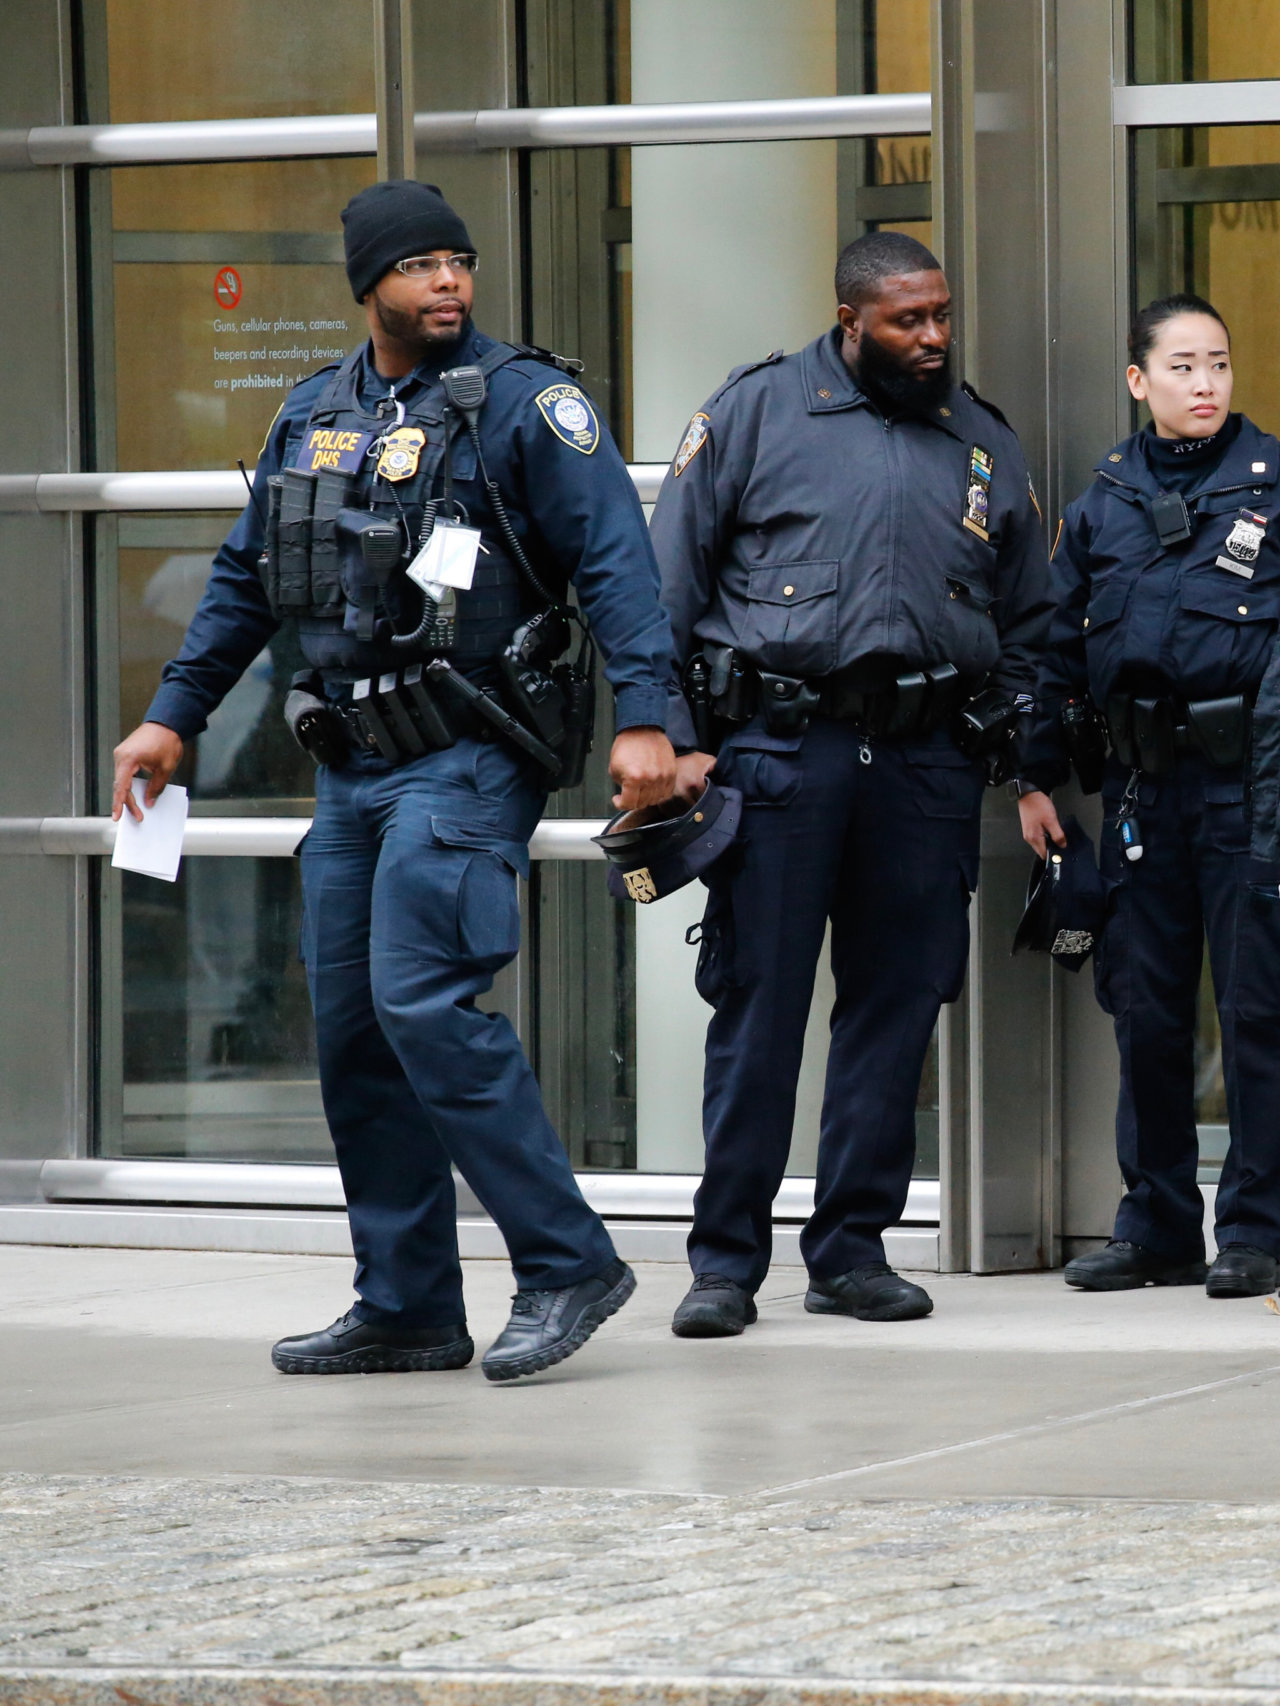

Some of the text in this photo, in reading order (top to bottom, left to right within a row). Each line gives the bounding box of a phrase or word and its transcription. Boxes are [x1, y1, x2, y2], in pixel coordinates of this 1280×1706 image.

[213, 317, 348, 334] Guns, cellular phones, cameras,
[213, 345, 344, 363] beepers and recording devices
[214, 379, 228, 389] are
[230, 374, 283, 392] prohibited
[286, 375, 294, 387] in
[541, 388, 580, 407] POLICE
[308, 430, 362, 451] POLICE
[311, 450, 341, 470] DHS
